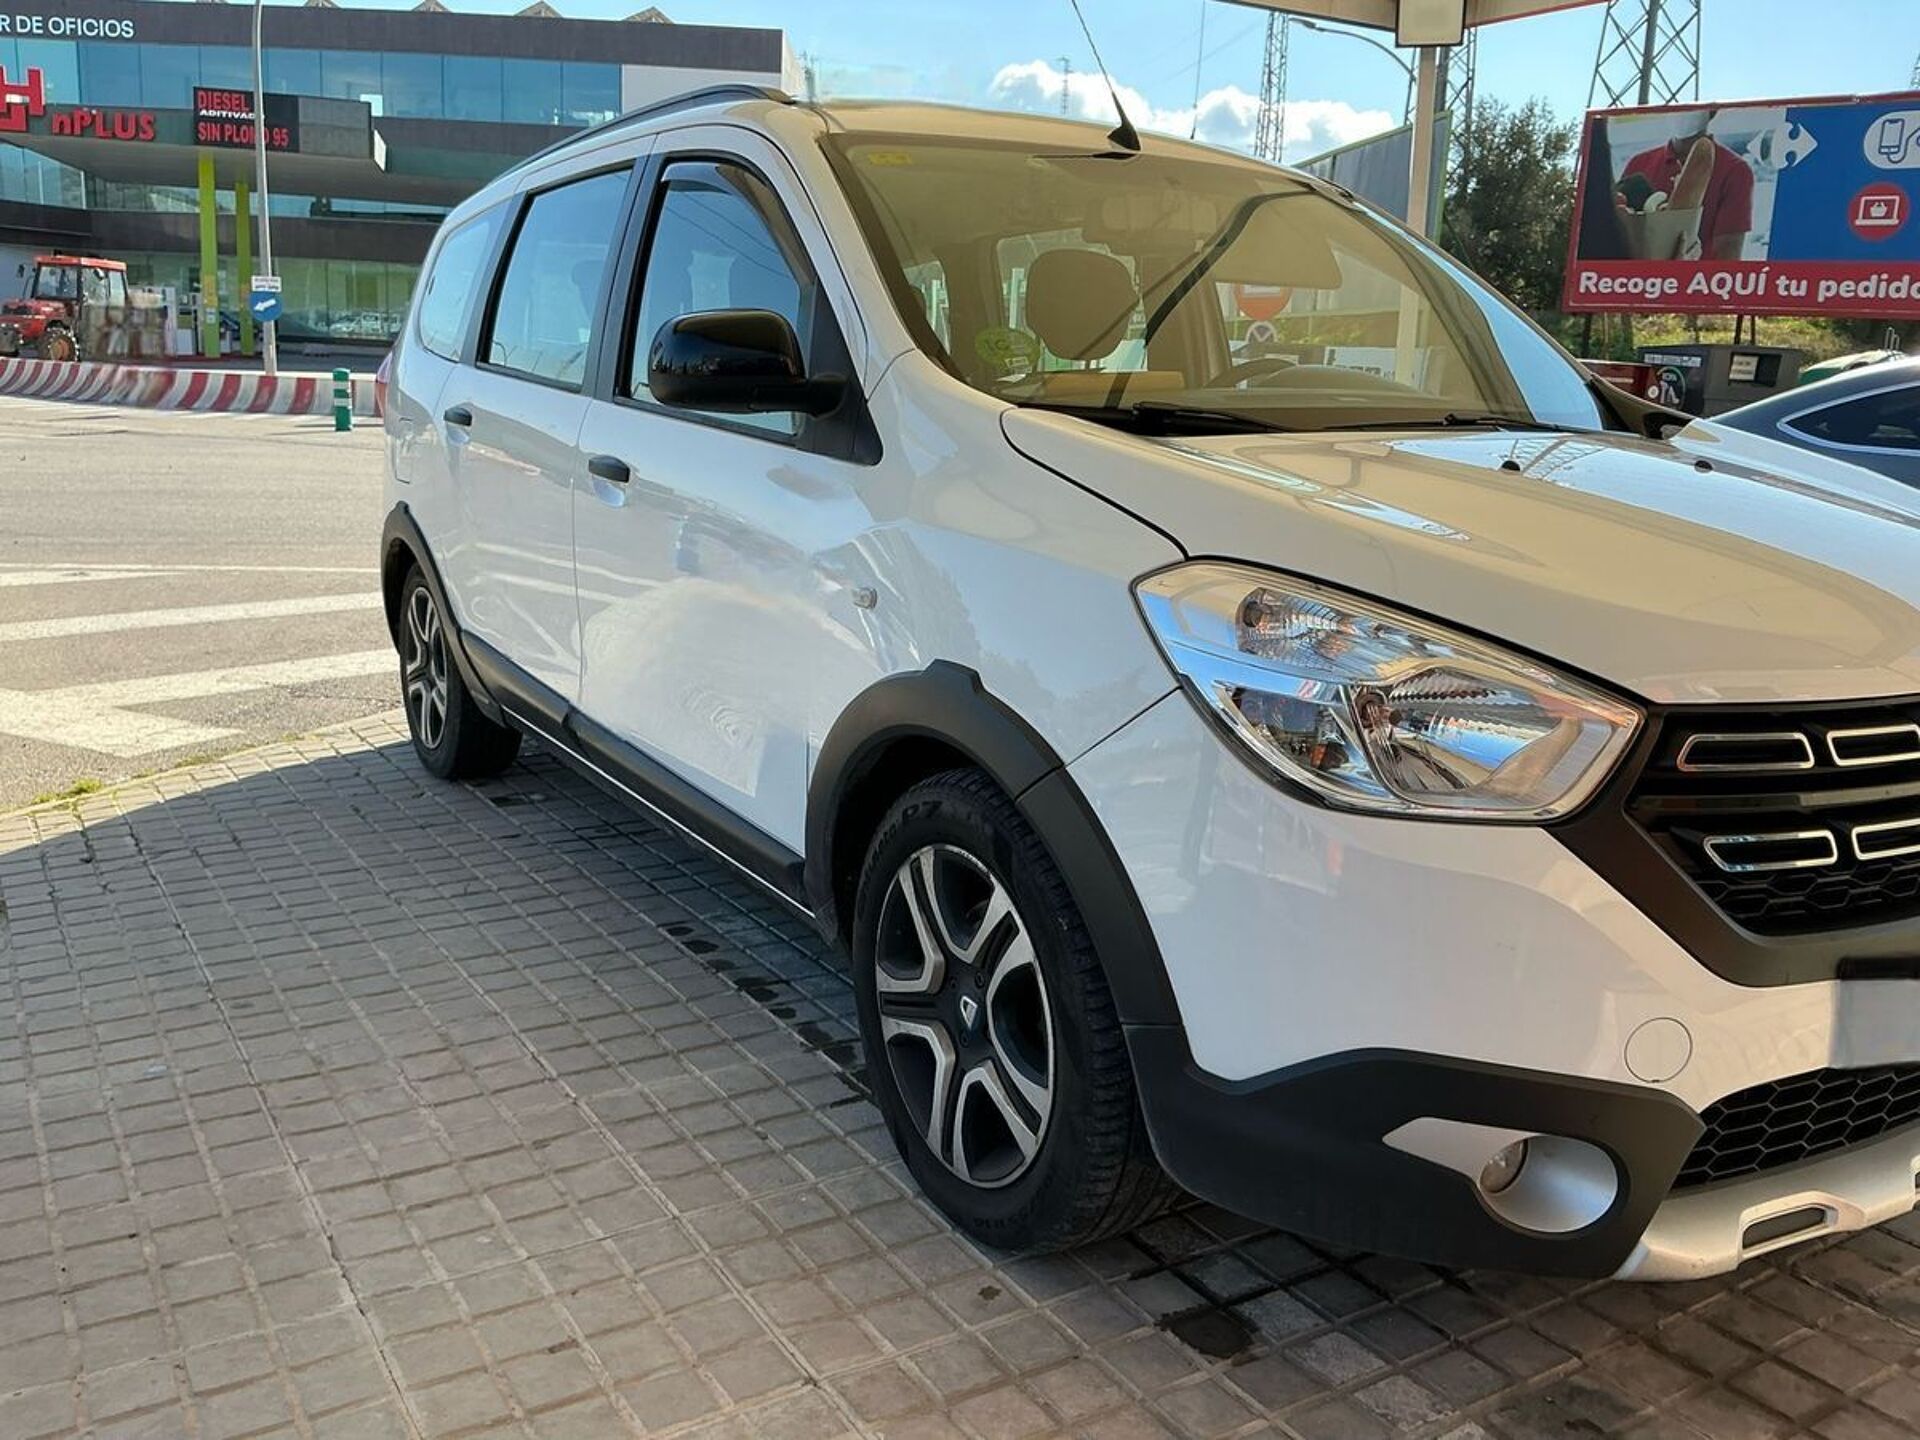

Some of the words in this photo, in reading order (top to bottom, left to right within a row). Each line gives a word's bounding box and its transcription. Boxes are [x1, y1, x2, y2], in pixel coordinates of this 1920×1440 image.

[16, 16, 43, 33] DE
[48, 17, 134, 38] OFICIOS
[197, 90, 249, 111] DIESEL
[197, 122, 220, 141] SIN
[273, 127, 289, 148] 95
[1579, 271, 1678, 298] Recoge
[1686, 267, 1770, 300] AQUÍ
[1776, 275, 1808, 296] tu
